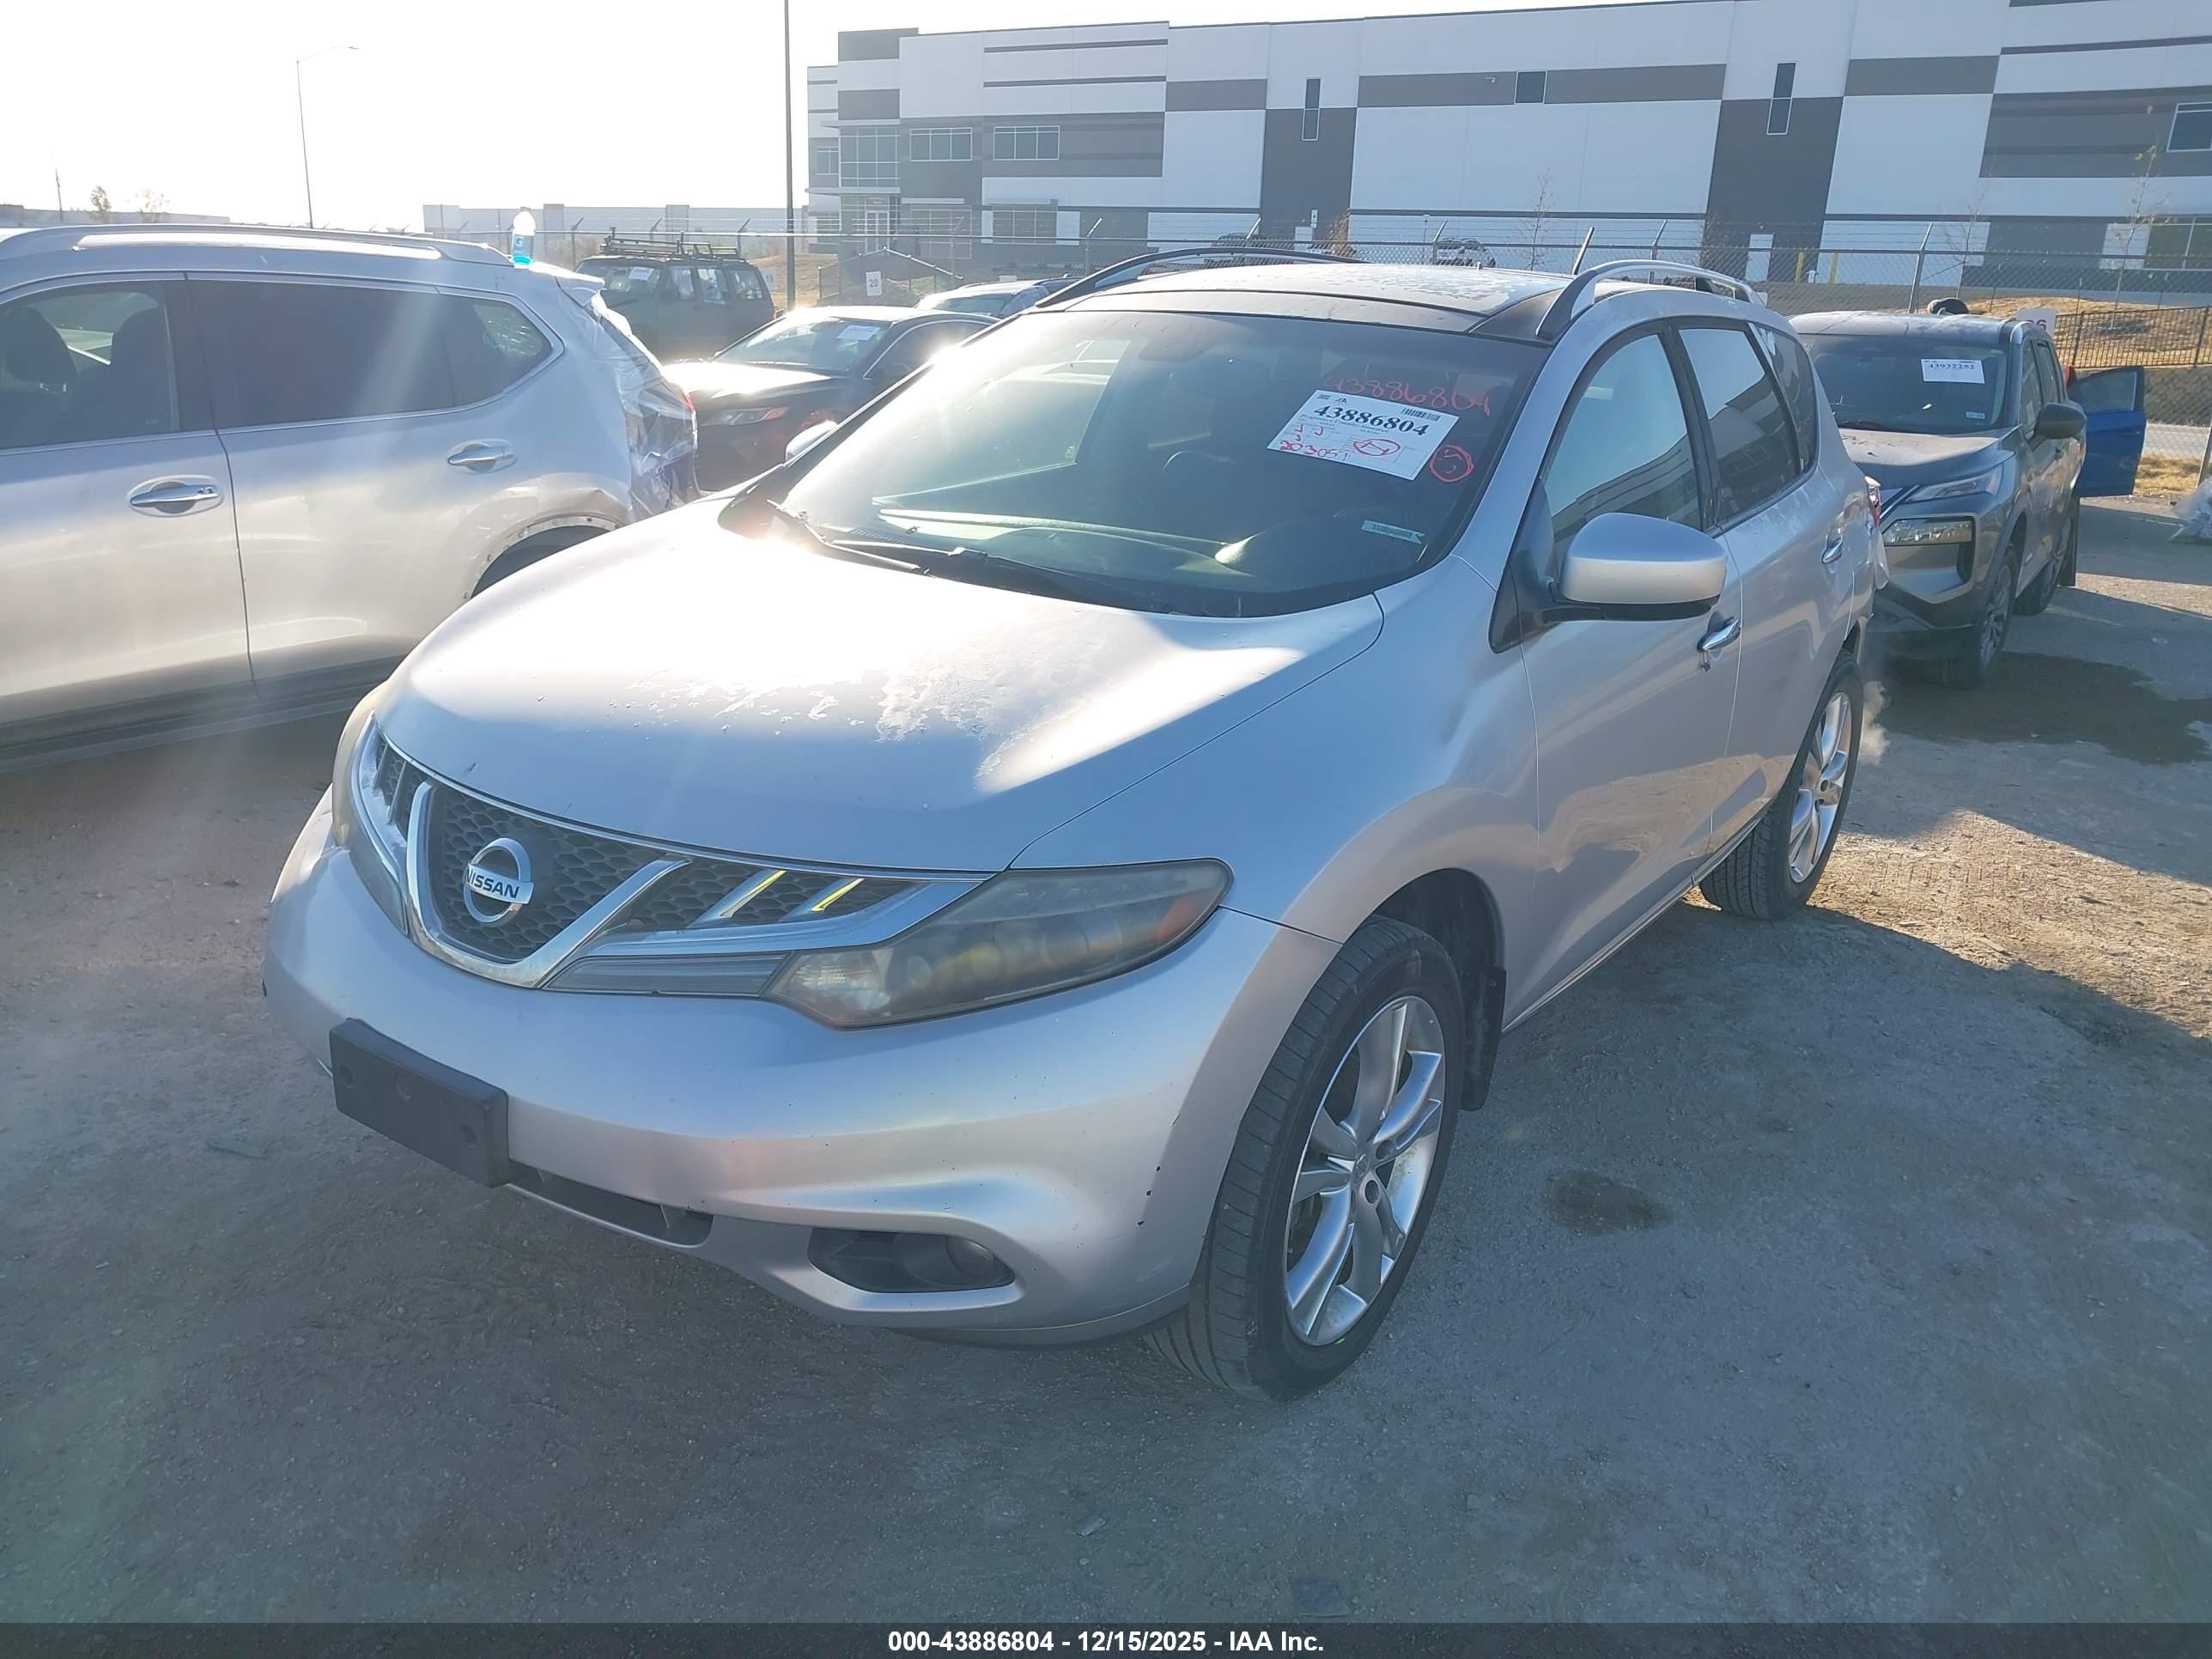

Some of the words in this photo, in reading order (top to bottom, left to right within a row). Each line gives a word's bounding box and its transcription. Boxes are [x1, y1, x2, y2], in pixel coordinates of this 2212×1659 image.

[869, 278, 879, 289] 20
[1314, 405, 1430, 436] 43886804
[465, 866, 520, 899] NISSAN
